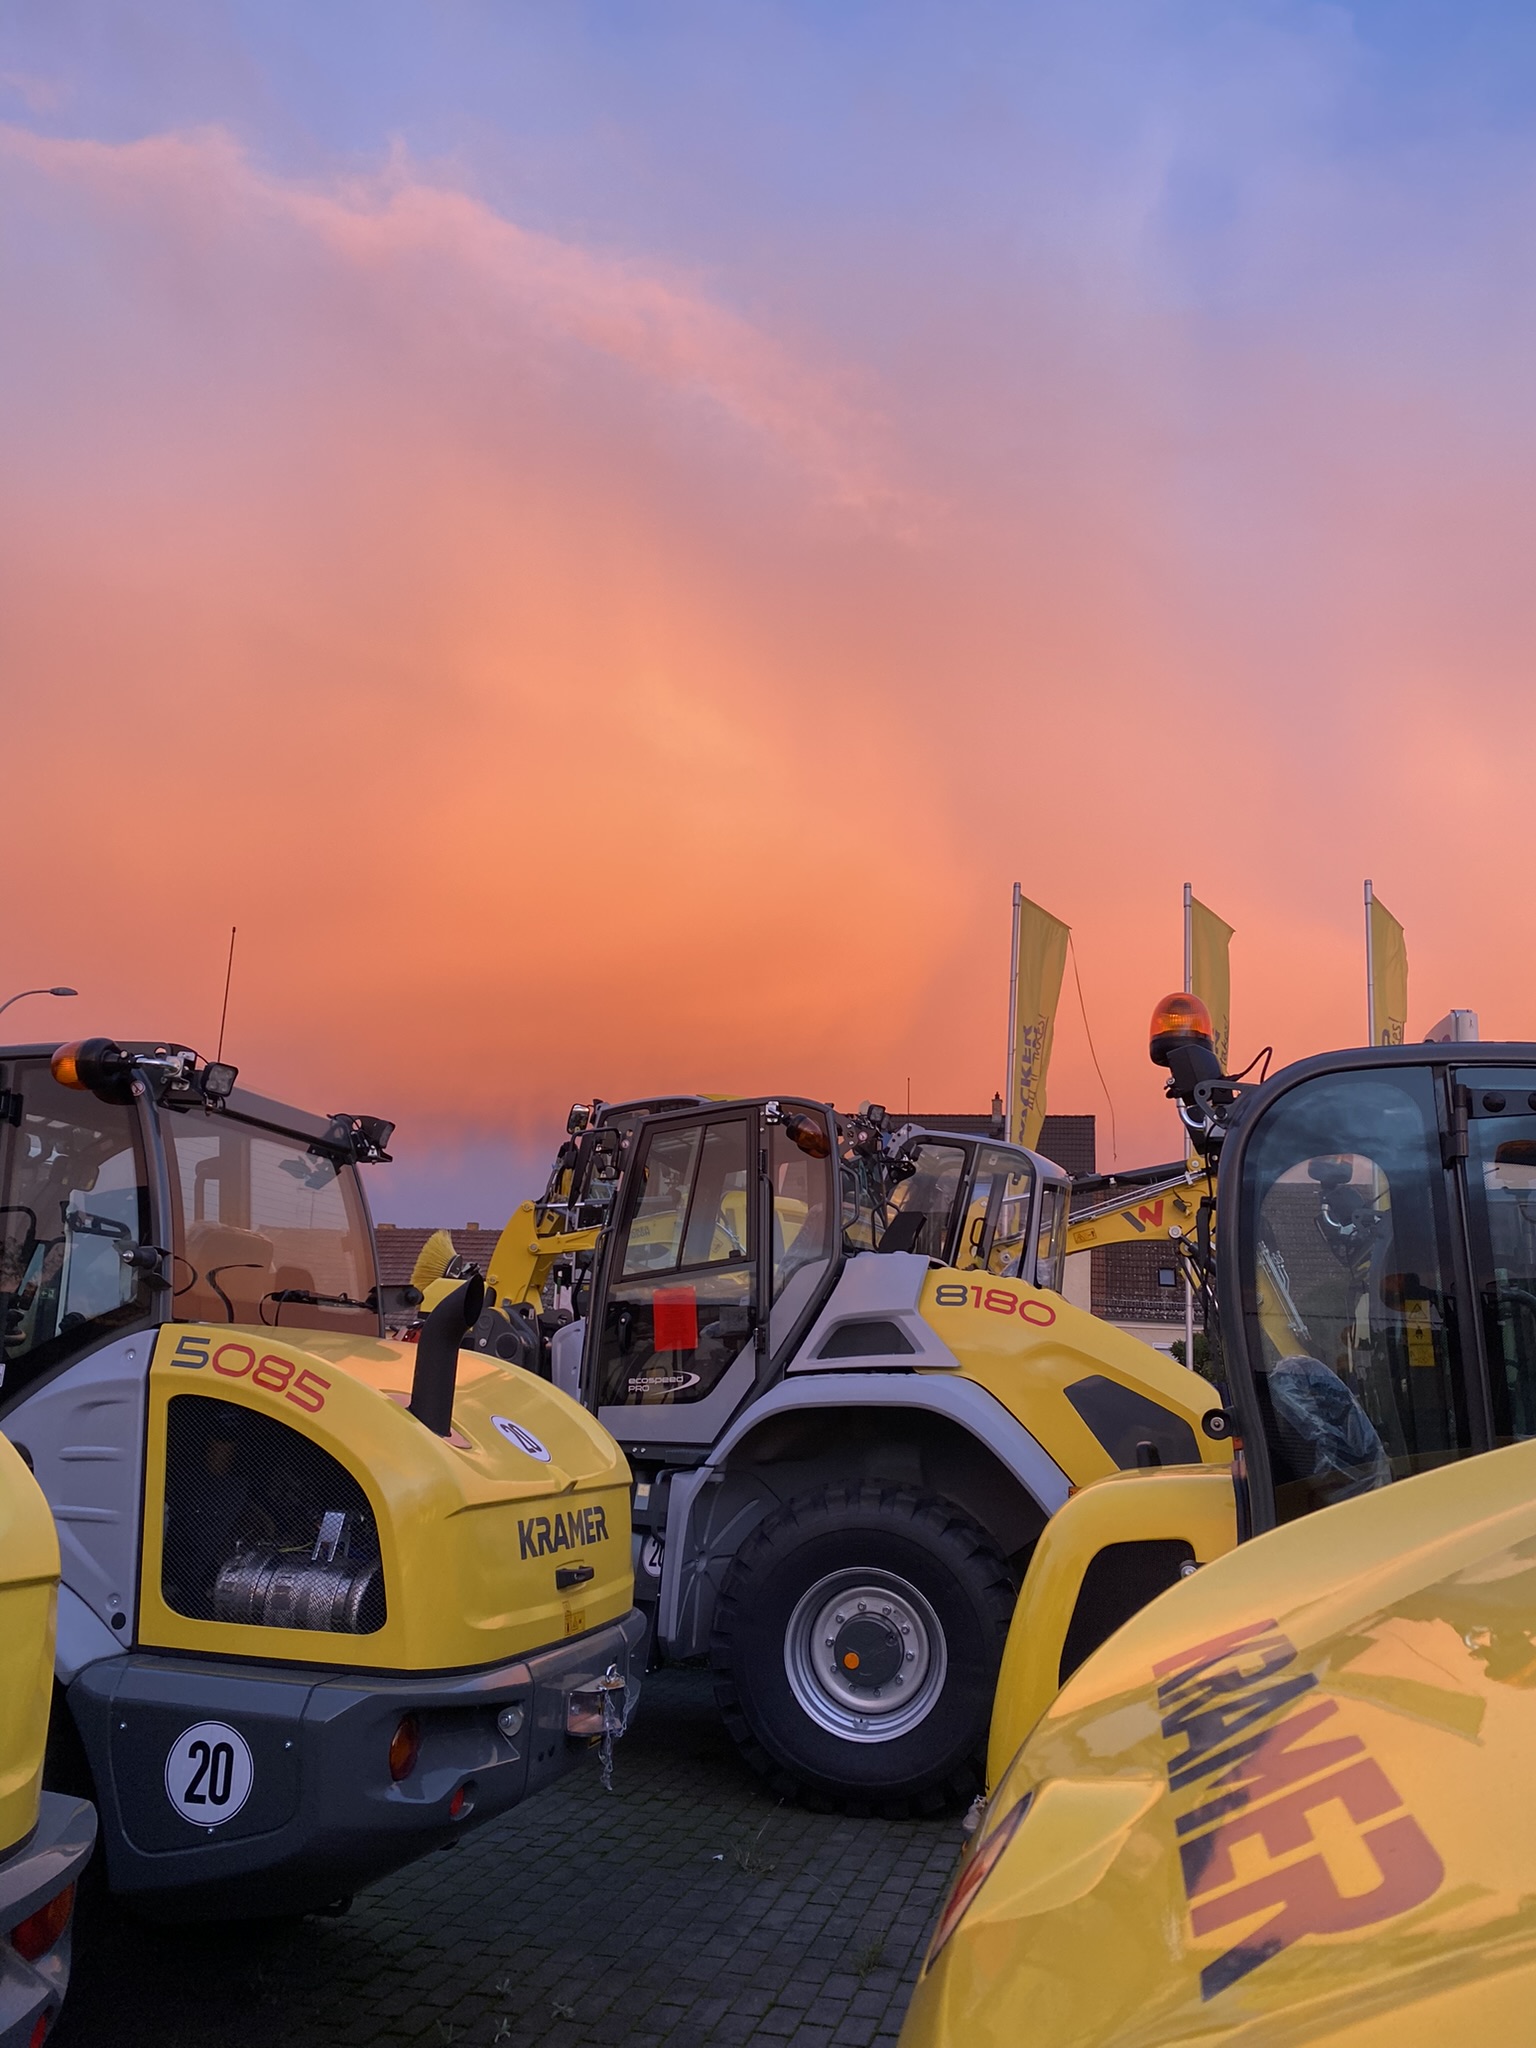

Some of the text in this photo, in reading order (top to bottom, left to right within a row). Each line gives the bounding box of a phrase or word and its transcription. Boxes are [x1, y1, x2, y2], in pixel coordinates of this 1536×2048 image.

[935, 1284, 1056, 1327] 8180
[170, 1336, 332, 1413] 5085
[628, 1375, 684, 1385] ecospeed
[628, 1384, 650, 1393] PRO
[500, 1423, 543, 1454] 20
[517, 1505, 609, 1561] KRAMER
[183, 1740, 235, 1806] 20
[1152, 1618, 1445, 2001] KRAMER
